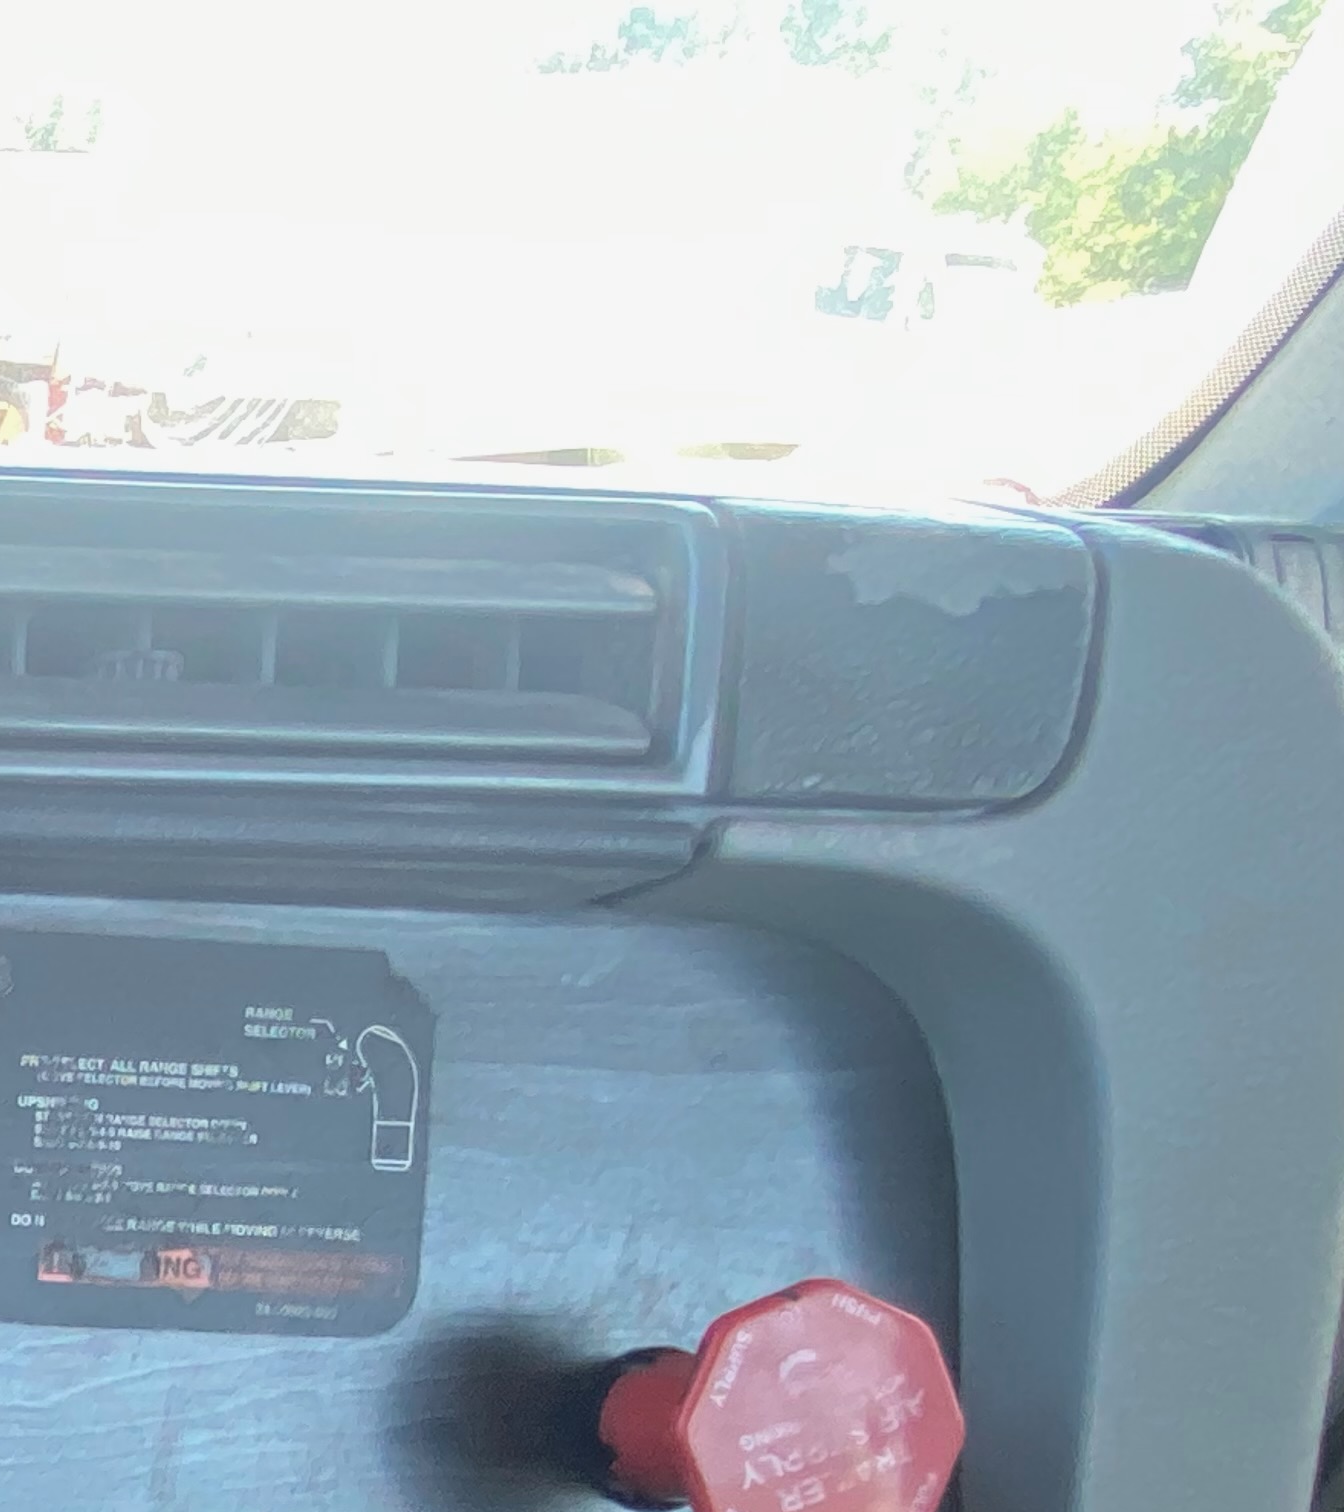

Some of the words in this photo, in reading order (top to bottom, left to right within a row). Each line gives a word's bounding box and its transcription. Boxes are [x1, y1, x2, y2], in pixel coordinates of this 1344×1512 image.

[245, 1007, 293, 1021] RANGE
[244, 1024, 316, 1040] SELECTOR
[110, 1058, 137, 1073] ALL
[139, 1060, 187, 1076] RANGE
